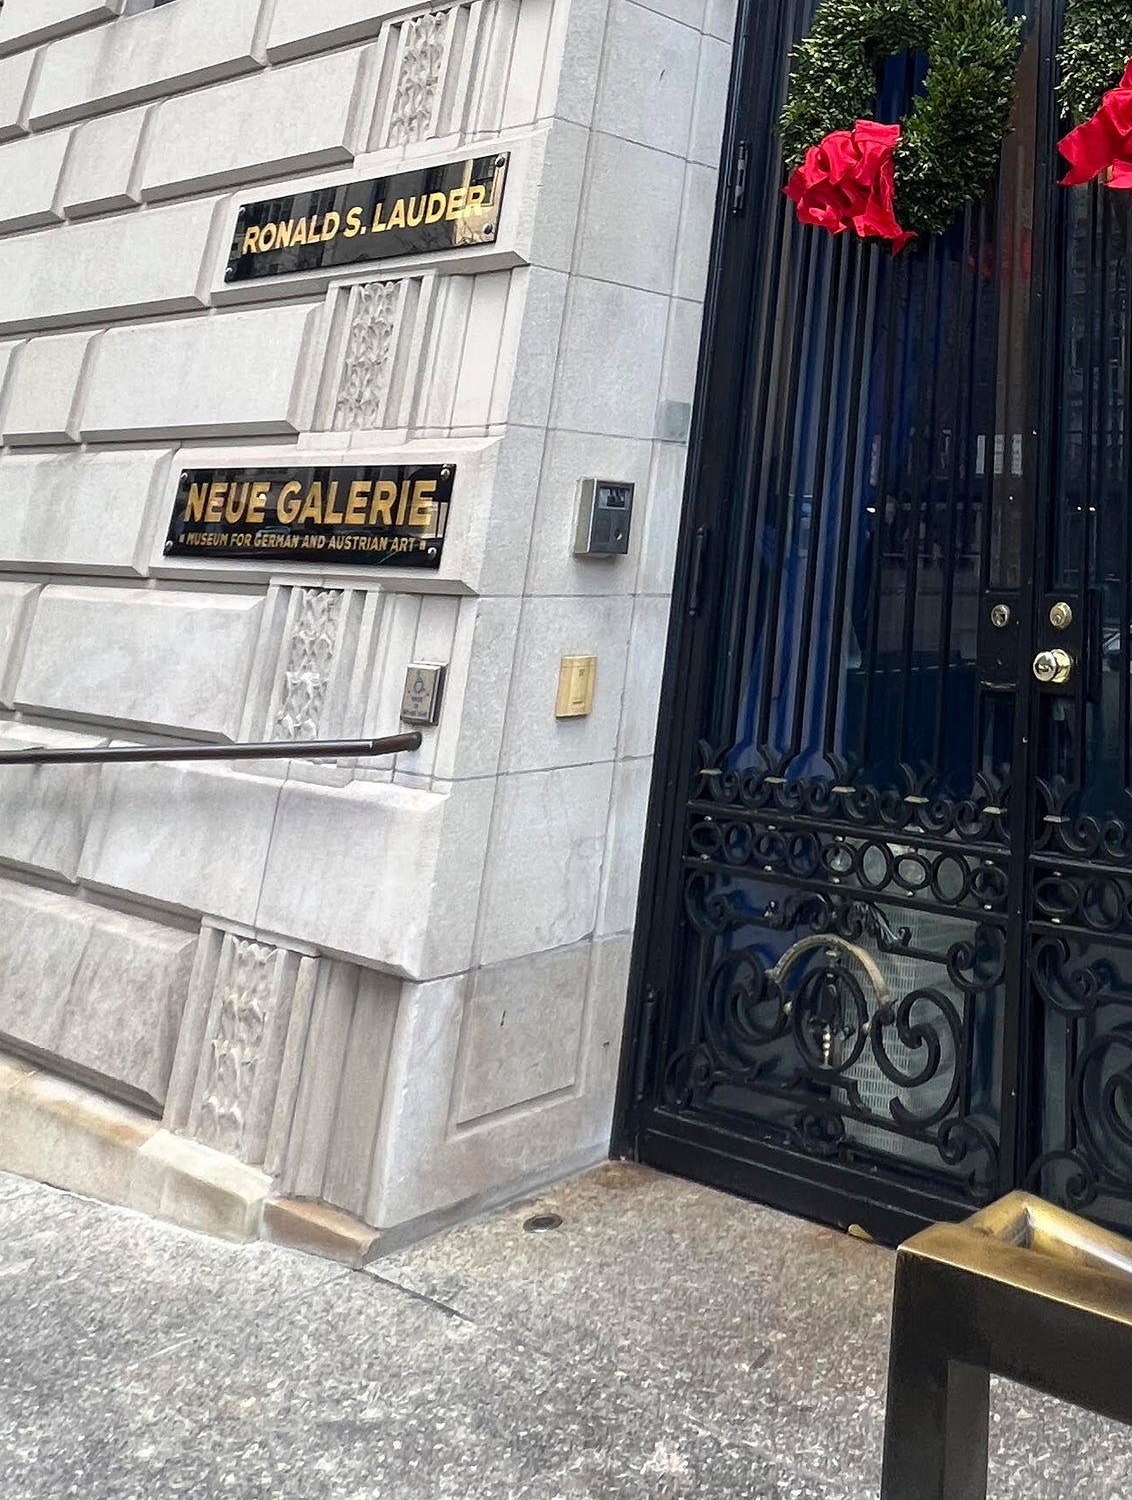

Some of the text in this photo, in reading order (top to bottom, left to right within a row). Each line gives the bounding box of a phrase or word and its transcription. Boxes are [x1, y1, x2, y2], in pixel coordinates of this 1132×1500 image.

[242, 184, 486, 255] RONALD S. LAUDER
[184, 479, 437, 527] NEUE GALERIE
[186, 533, 416, 552] MUSEUM FOR GERMAN AND AUSTRIAN ART
